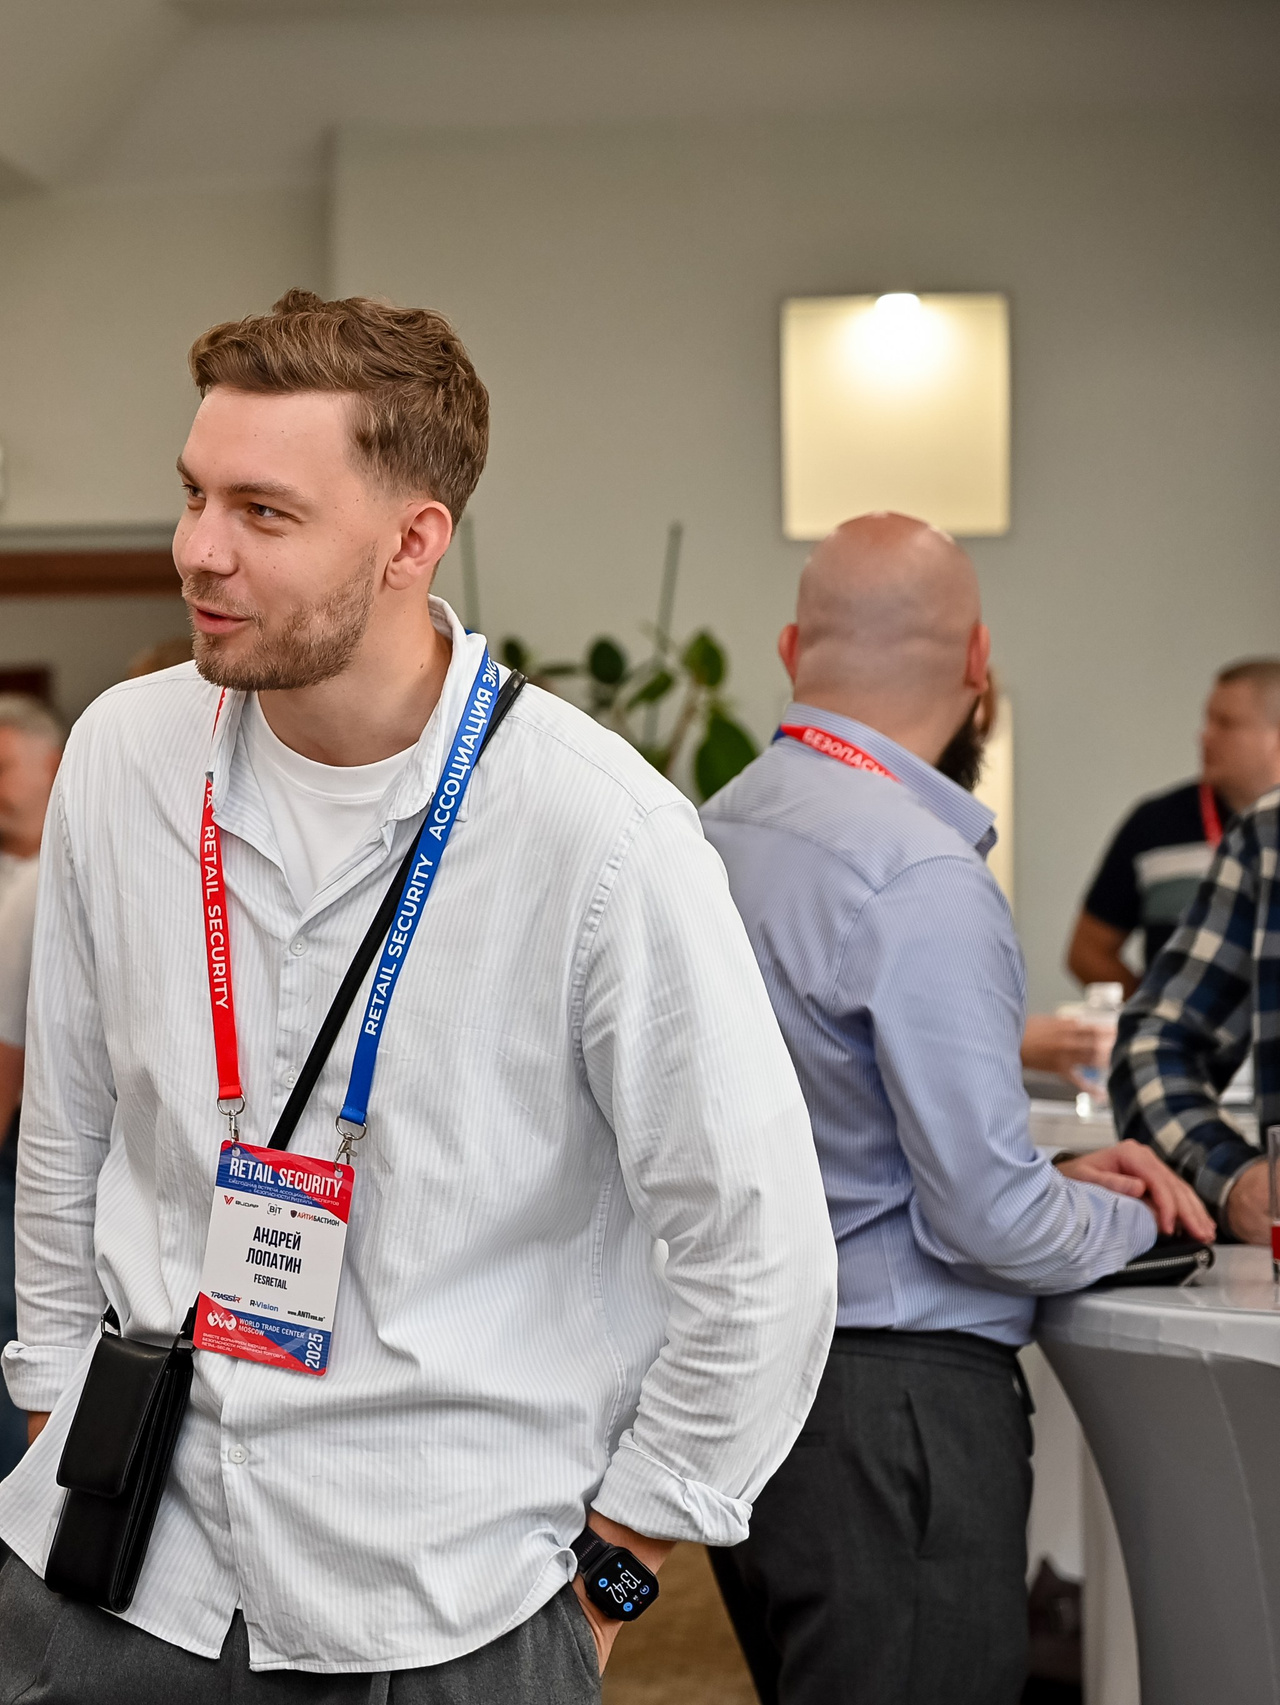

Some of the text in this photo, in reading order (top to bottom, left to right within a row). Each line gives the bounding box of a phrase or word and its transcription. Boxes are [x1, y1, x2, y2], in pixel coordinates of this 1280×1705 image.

[428, 687, 491, 841] АССОЦИАЦИЯ
[204, 826, 229, 1009] RETAIL SECURITY
[365, 853, 434, 1036] RETAIL SECURITY
[229, 1157, 343, 1198] RETAIL SECURITY
[253, 1226, 301, 1251] АНДРЕЙ
[246, 1248, 302, 1274] ЛОПАТИН
[253, 1274, 287, 1290] FESRETAIL
[238, 1325, 265, 1336] MOSCOW
[239, 1318, 305, 1338] WORLD TRADE CENTER
[304, 1332, 324, 1369] 2025
[606, 1569, 641, 1604] 13:42
